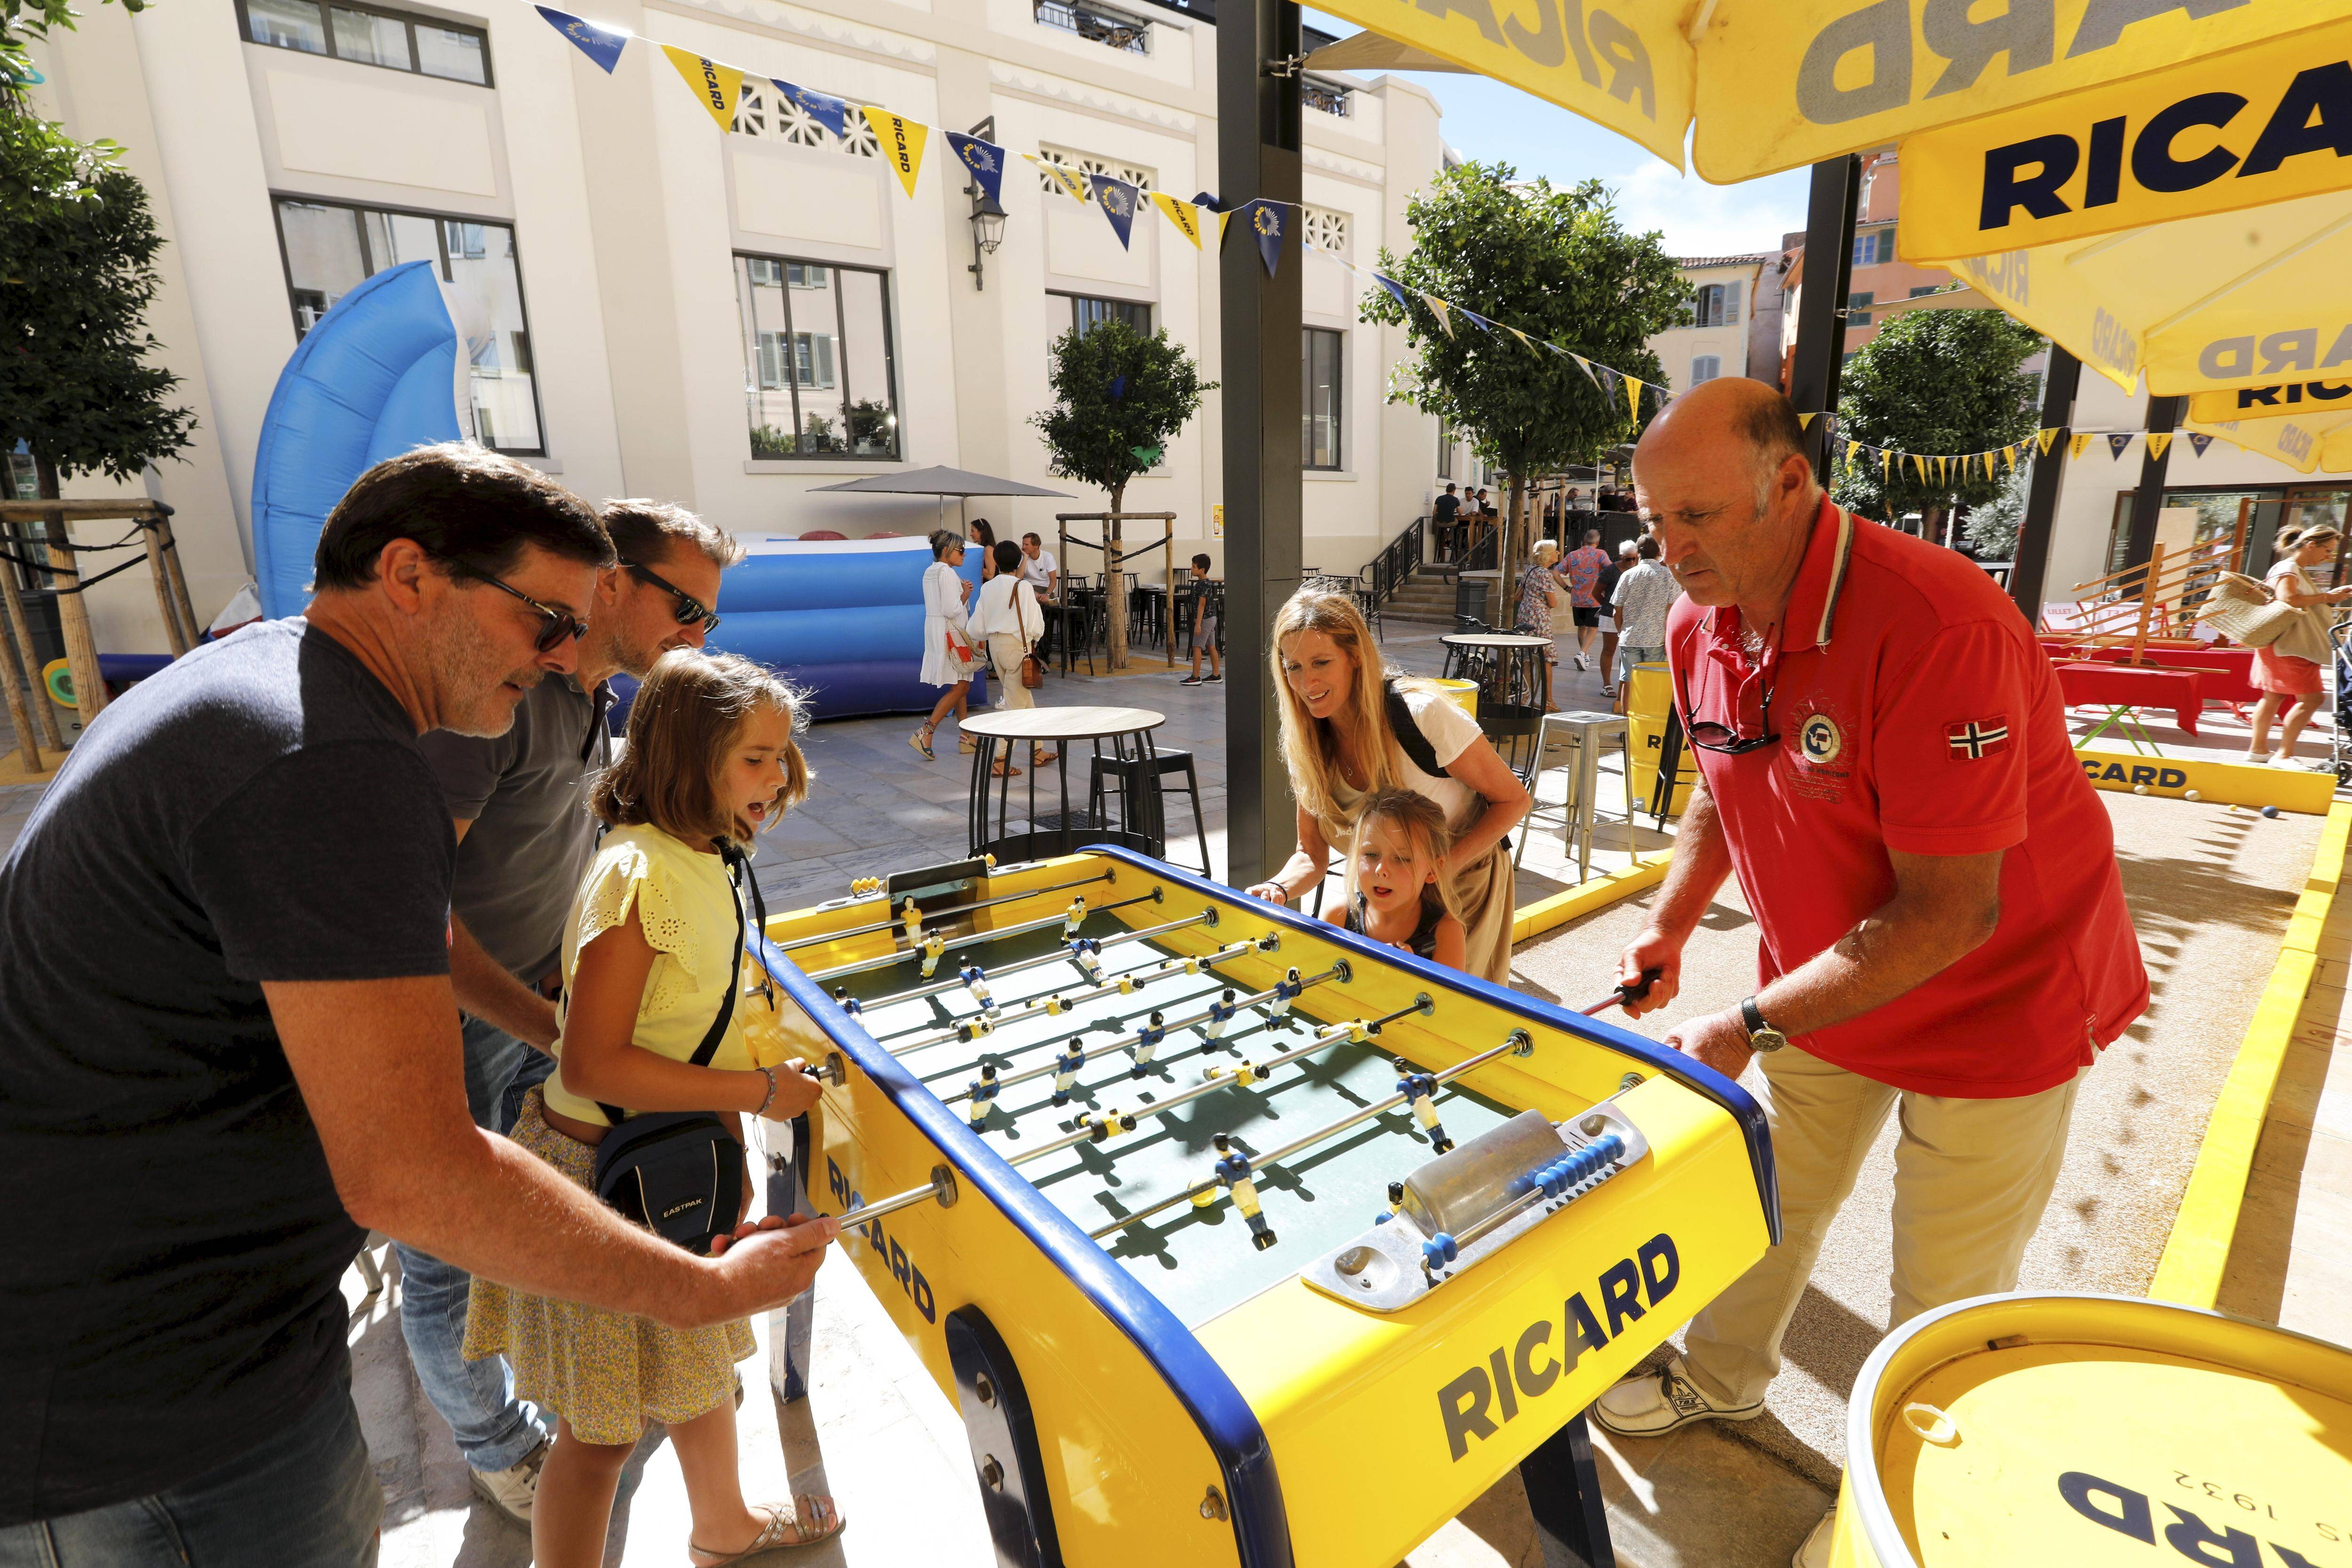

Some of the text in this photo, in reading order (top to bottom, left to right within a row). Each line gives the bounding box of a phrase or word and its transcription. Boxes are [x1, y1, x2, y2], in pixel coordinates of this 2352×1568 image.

[699, 57, 725, 110] RICARD
[892, 117, 910, 173] RICARD
[963, 143, 980, 169] RICARD
[1103, 186, 1116, 214] RICARD
[1171, 199, 1194, 235] RICARD
[1254, 207, 1267, 235] RICARD
[664, 1198, 702, 1218] EASTPAK
[1437, 1233, 1679, 1463] RICARD
[2173, 1470, 2278, 1520] 1932
